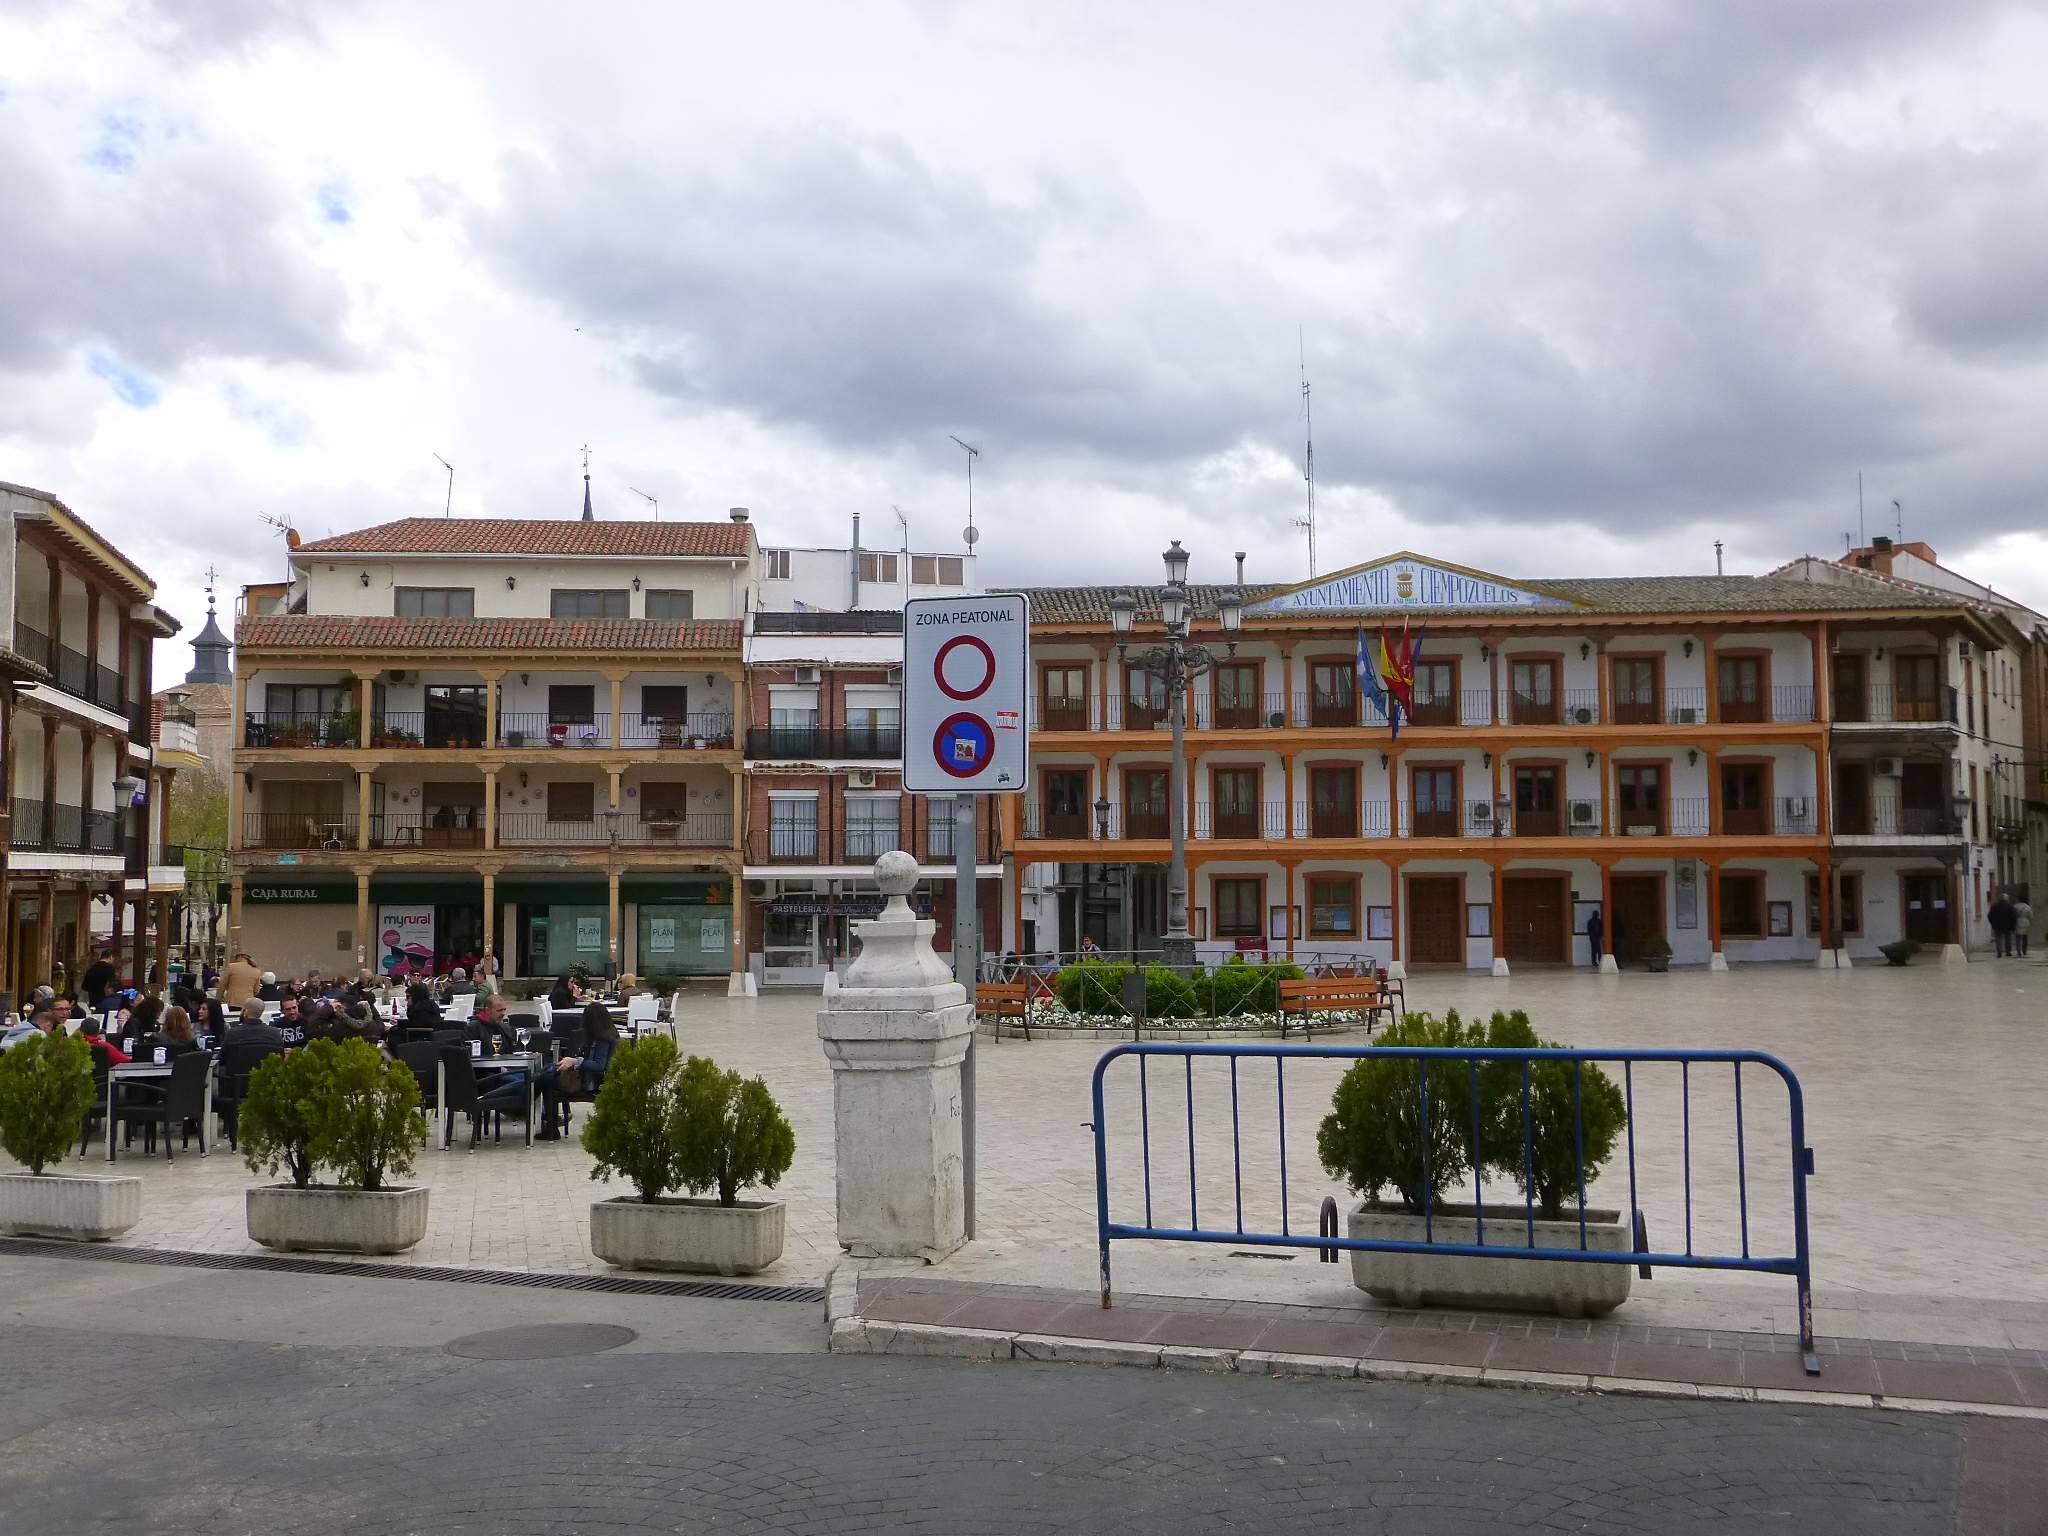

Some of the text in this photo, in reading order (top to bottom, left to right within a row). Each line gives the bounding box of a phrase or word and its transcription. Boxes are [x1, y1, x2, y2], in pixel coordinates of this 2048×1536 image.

[1293, 568, 1390, 607] AYUNTAMIENTO
[1420, 567, 1519, 604] CIEMPOZUELOS
[915, 609, 1014, 626] ZONA PEATONAL
[250, 888, 318, 900] CAJA RURAL
[384, 912, 431, 928] myrural
[578, 927, 600, 936] PLAN
[652, 928, 673, 937] PLAN
[702, 928, 723, 937] PLAN
